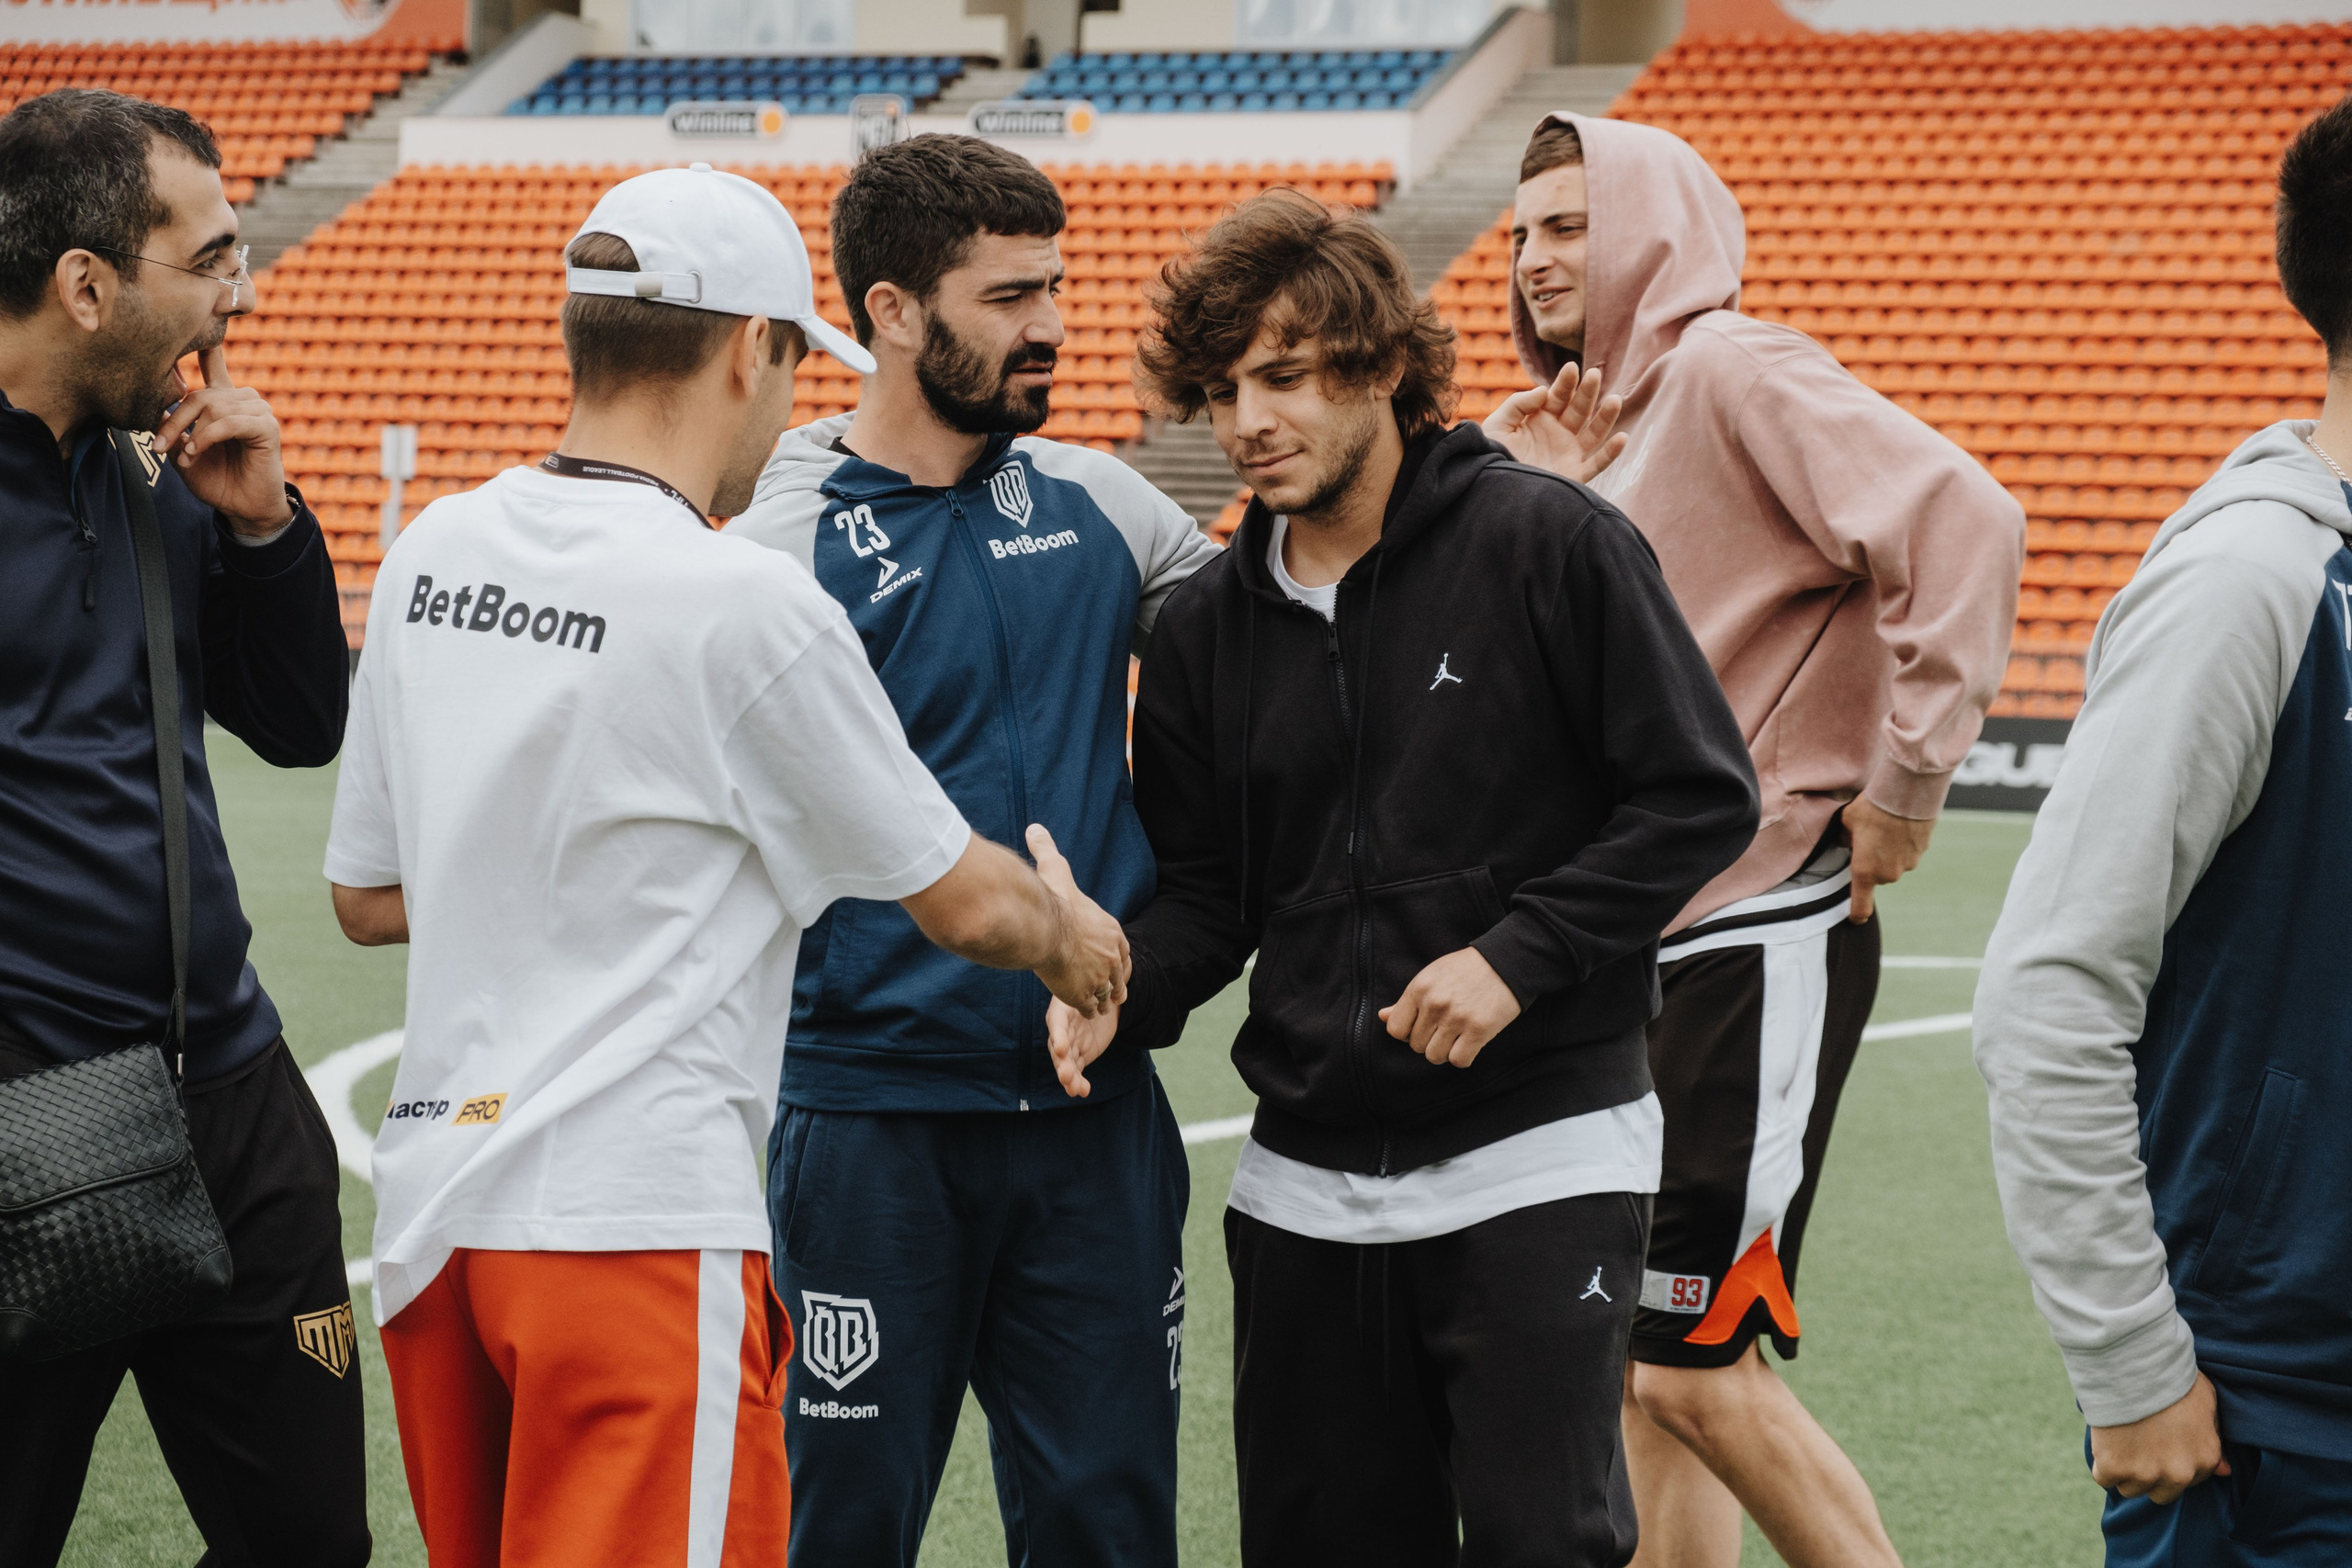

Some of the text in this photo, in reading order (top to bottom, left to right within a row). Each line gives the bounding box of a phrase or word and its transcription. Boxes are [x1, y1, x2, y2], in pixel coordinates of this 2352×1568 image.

[582, 466, 606, 474] LEAGUE
[606, 468, 639, 479] FOOTBALL
[834, 503, 891, 558] 23
[988, 529, 1080, 559] BetBoom
[870, 567, 923, 604] DEMIX
[406, 574, 606, 653] BetBoom
[456, 1099, 501, 1122] PRO
[1671, 1278, 1702, 1307] 93
[799, 1397, 879, 1419] BetBoom
